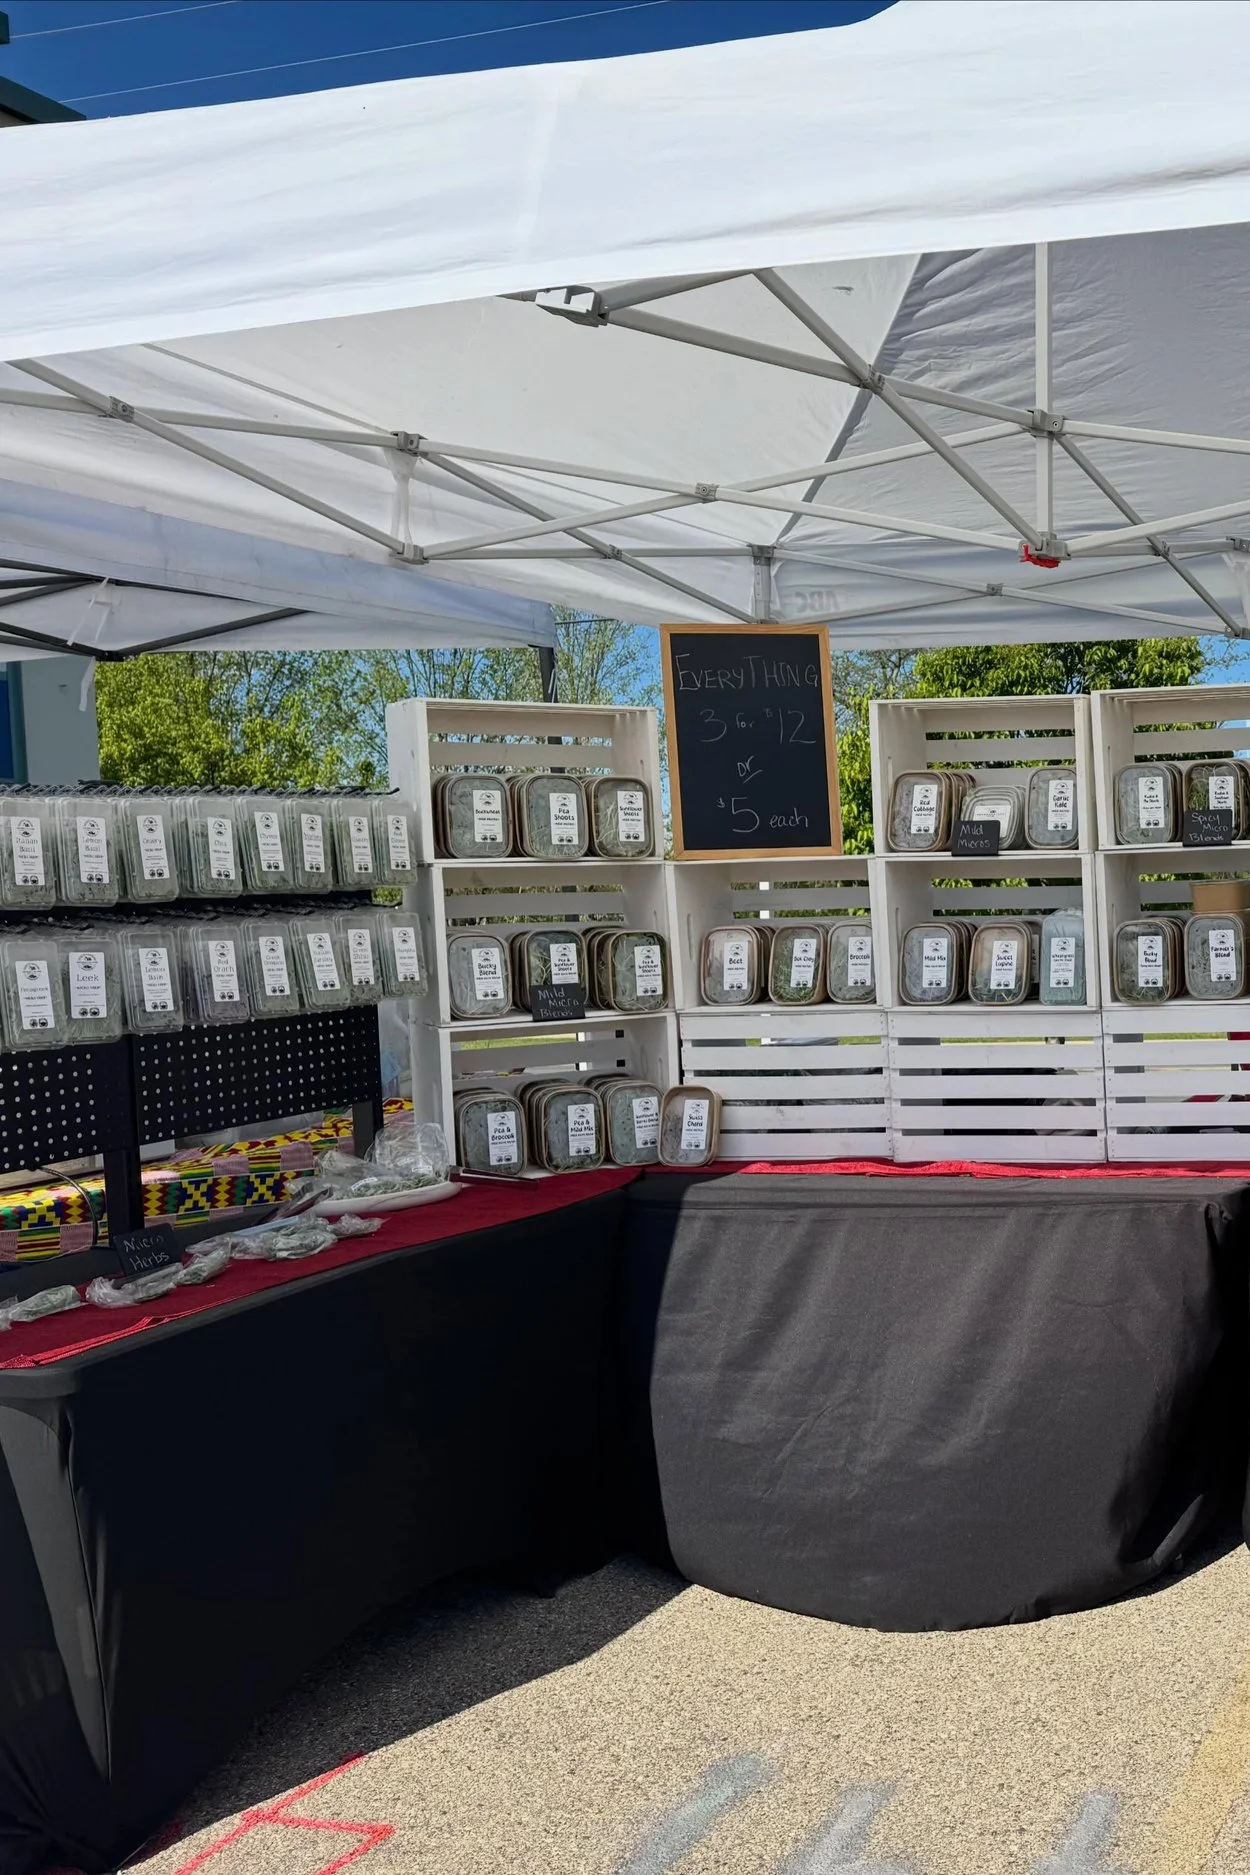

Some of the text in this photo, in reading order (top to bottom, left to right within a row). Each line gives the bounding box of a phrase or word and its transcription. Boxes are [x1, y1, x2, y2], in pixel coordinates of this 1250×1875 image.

[675, 653, 818, 691] EVERYTHING
[699, 709, 727, 742] 3
[736, 712, 754, 729] for
[769, 808, 808, 828] each
[1192, 813, 1220, 824] Spicy
[960, 824, 984, 836] Mild
[1202, 824, 1228, 832] Micro
[77, 974, 99, 982] Leek
[538, 988, 565, 1000] Mild
[491, 1133, 515, 1141] Broccoli
[123, 1235, 164, 1253] Micro
[129, 1252, 170, 1271] Herbs
